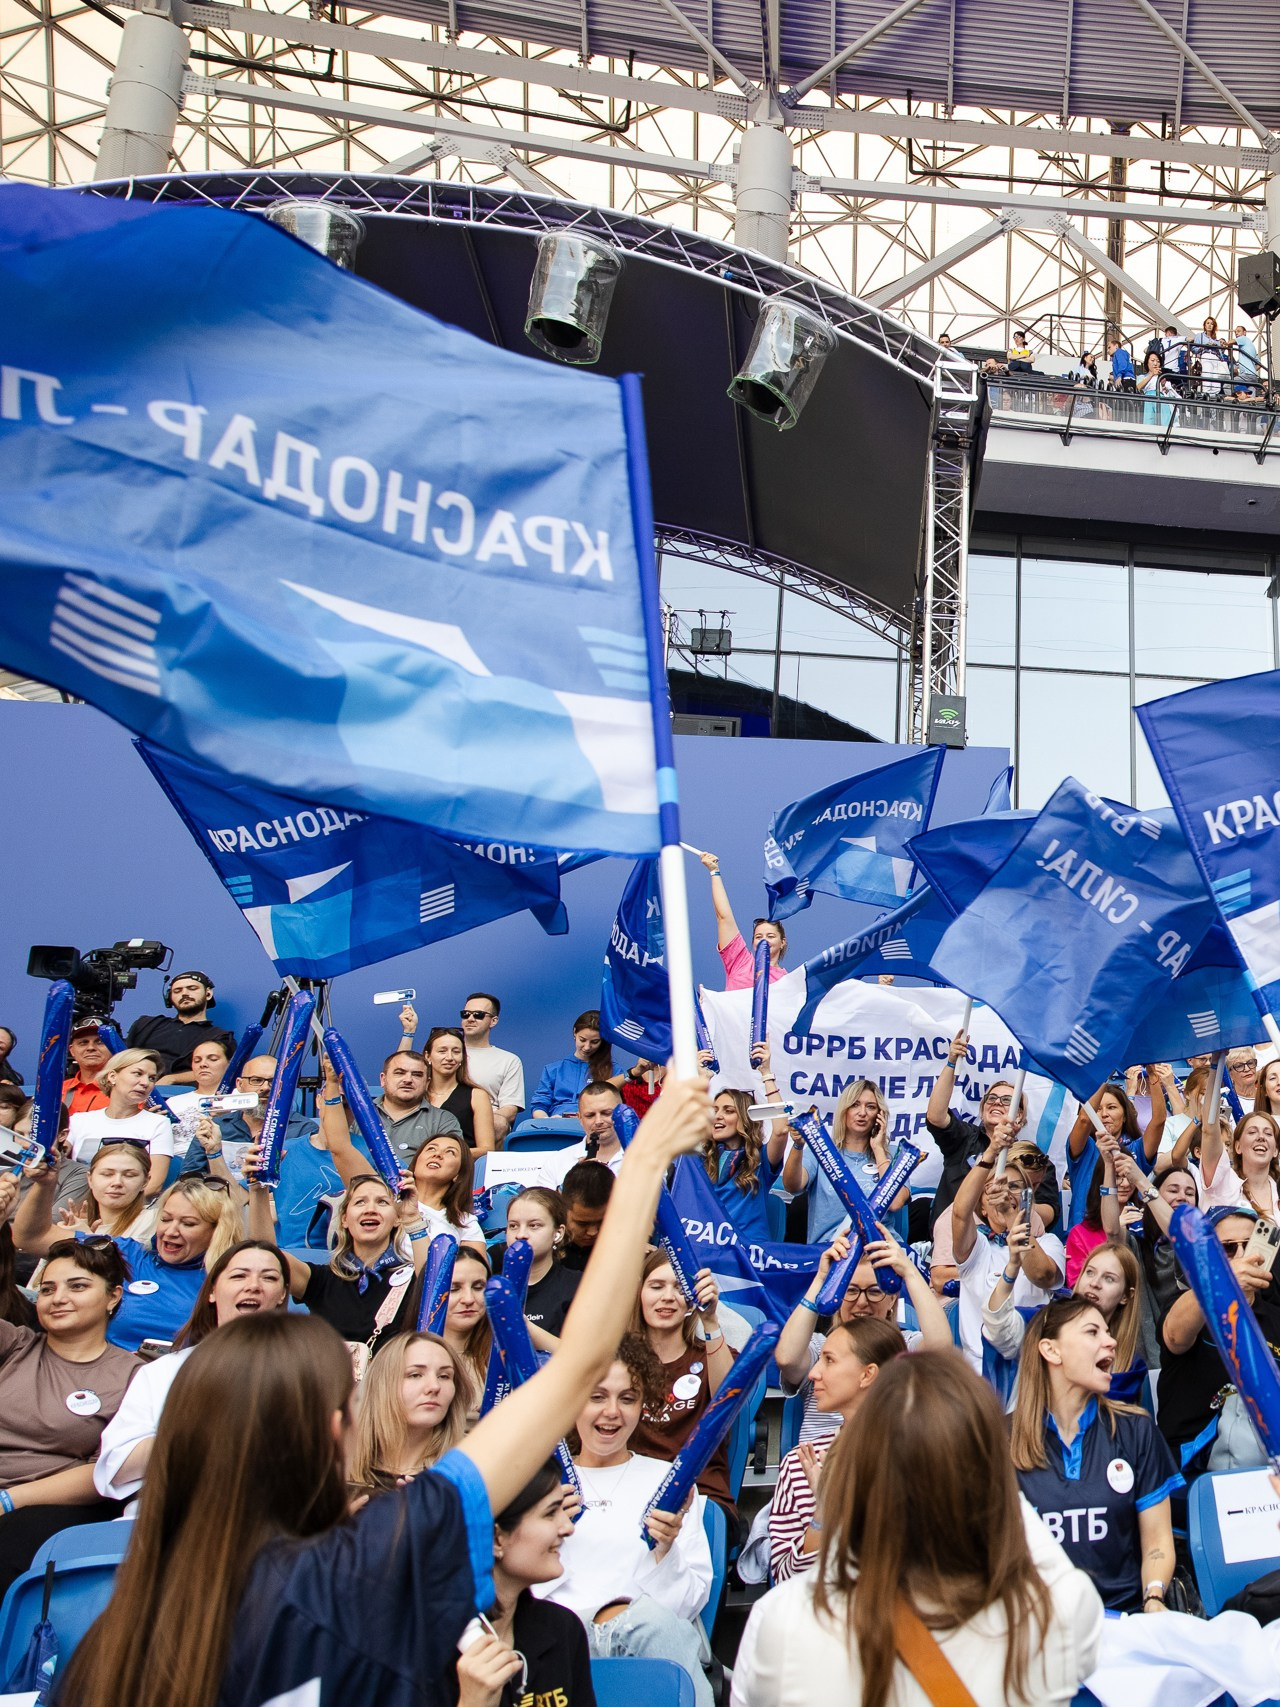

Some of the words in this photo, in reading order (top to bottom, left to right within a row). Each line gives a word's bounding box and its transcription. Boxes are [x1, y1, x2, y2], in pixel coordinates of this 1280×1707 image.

[207, 807, 371, 853] КРАСНОДА
[783, 1031, 867, 1060] ОРРБ
[790, 1071, 906, 1099] САМЕ
[824, 1150, 844, 1178] ГРУППЫ
[1042, 1507, 1109, 1543] ВТБ
